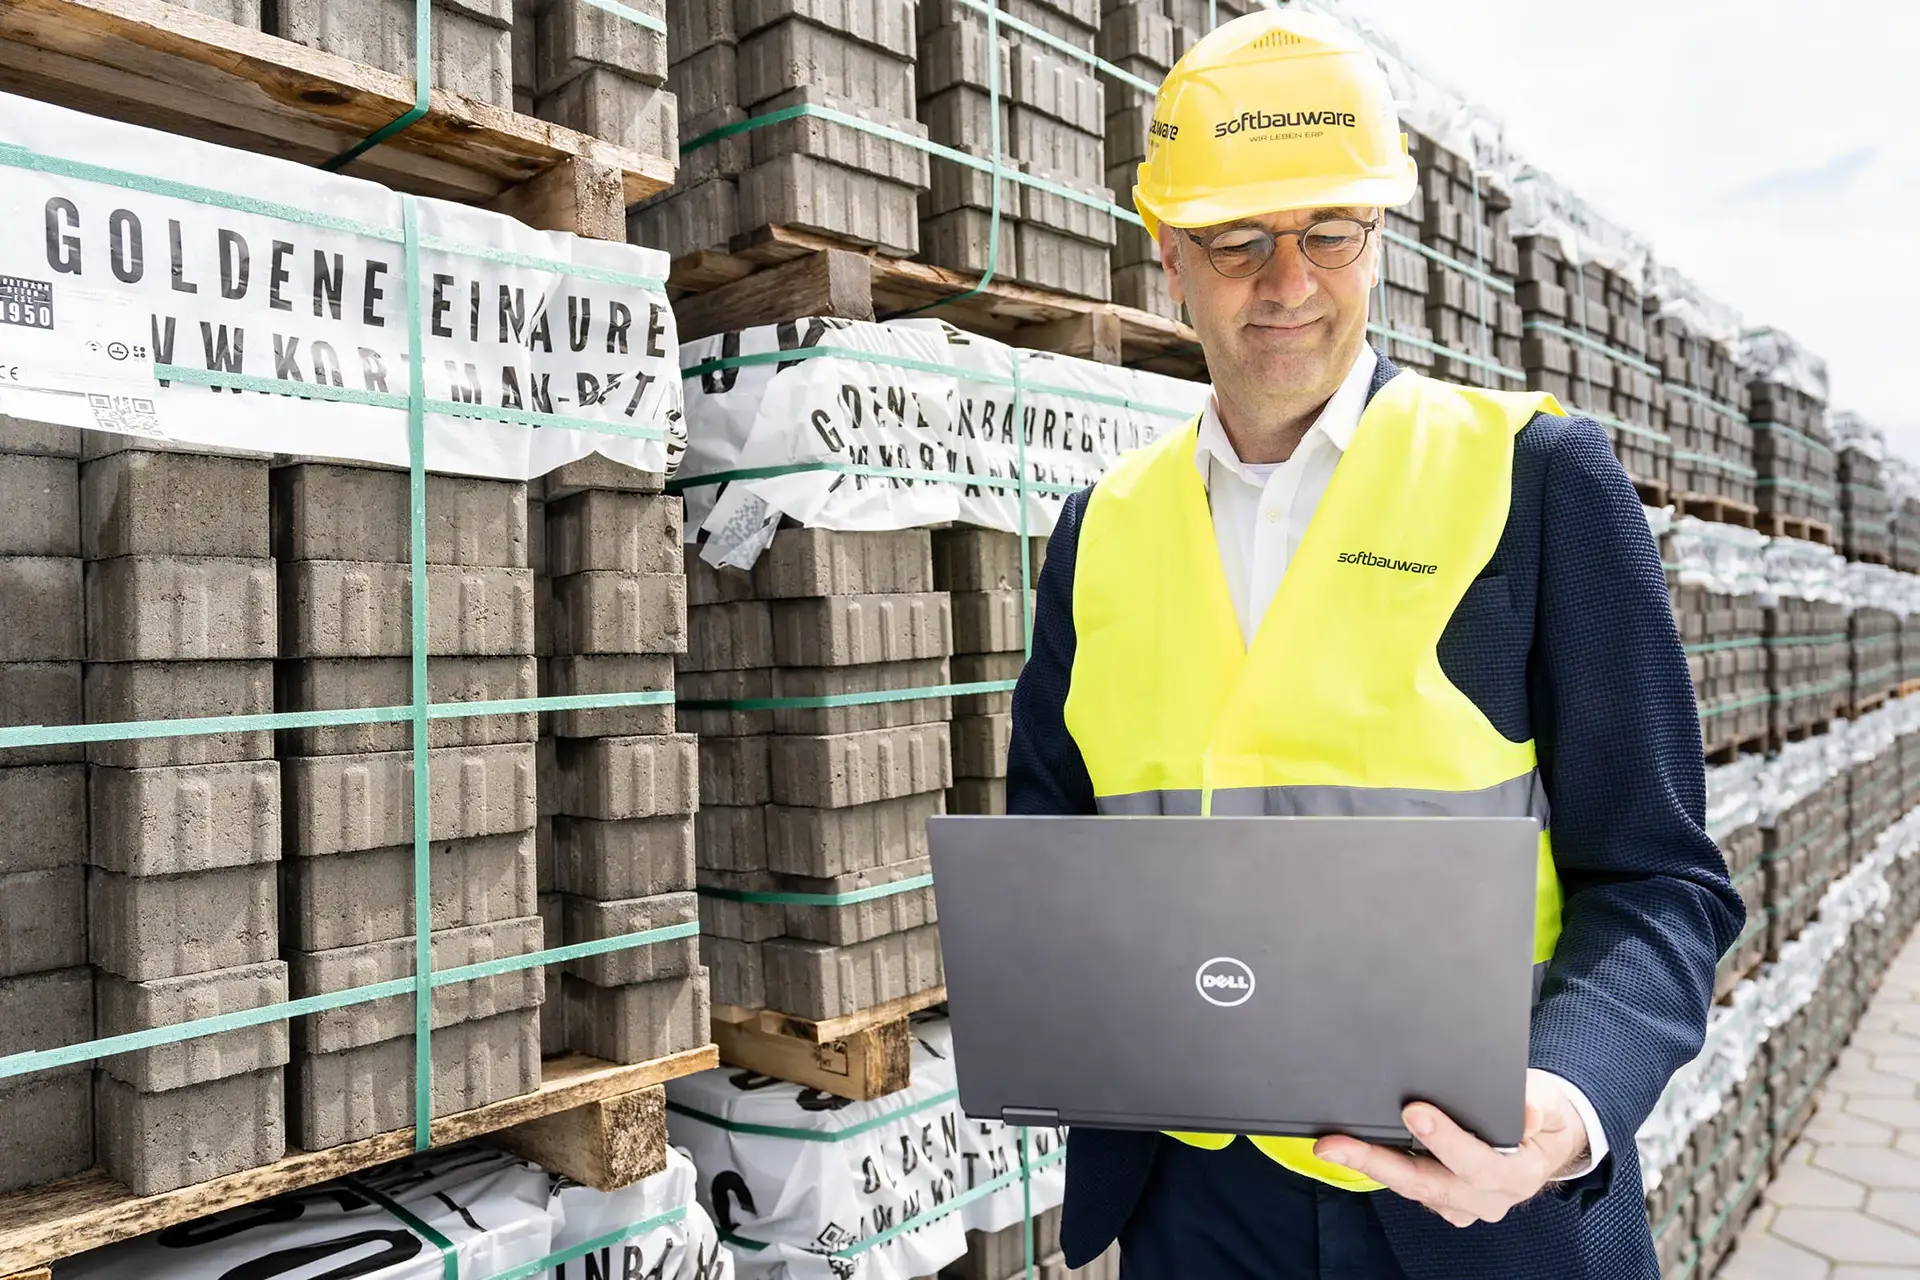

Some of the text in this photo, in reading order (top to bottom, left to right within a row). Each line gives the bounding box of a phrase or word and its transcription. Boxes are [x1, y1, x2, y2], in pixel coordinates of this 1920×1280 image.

[1215, 110, 1355, 138] softbauware
[1249, 131, 1324, 143] WIR LEBEN ERP
[44, 196, 388, 328] GOLDENE
[0, 300, 51, 327] 1950
[1337, 551, 1437, 575] softbauware
[1202, 974, 1249, 989] DELL
